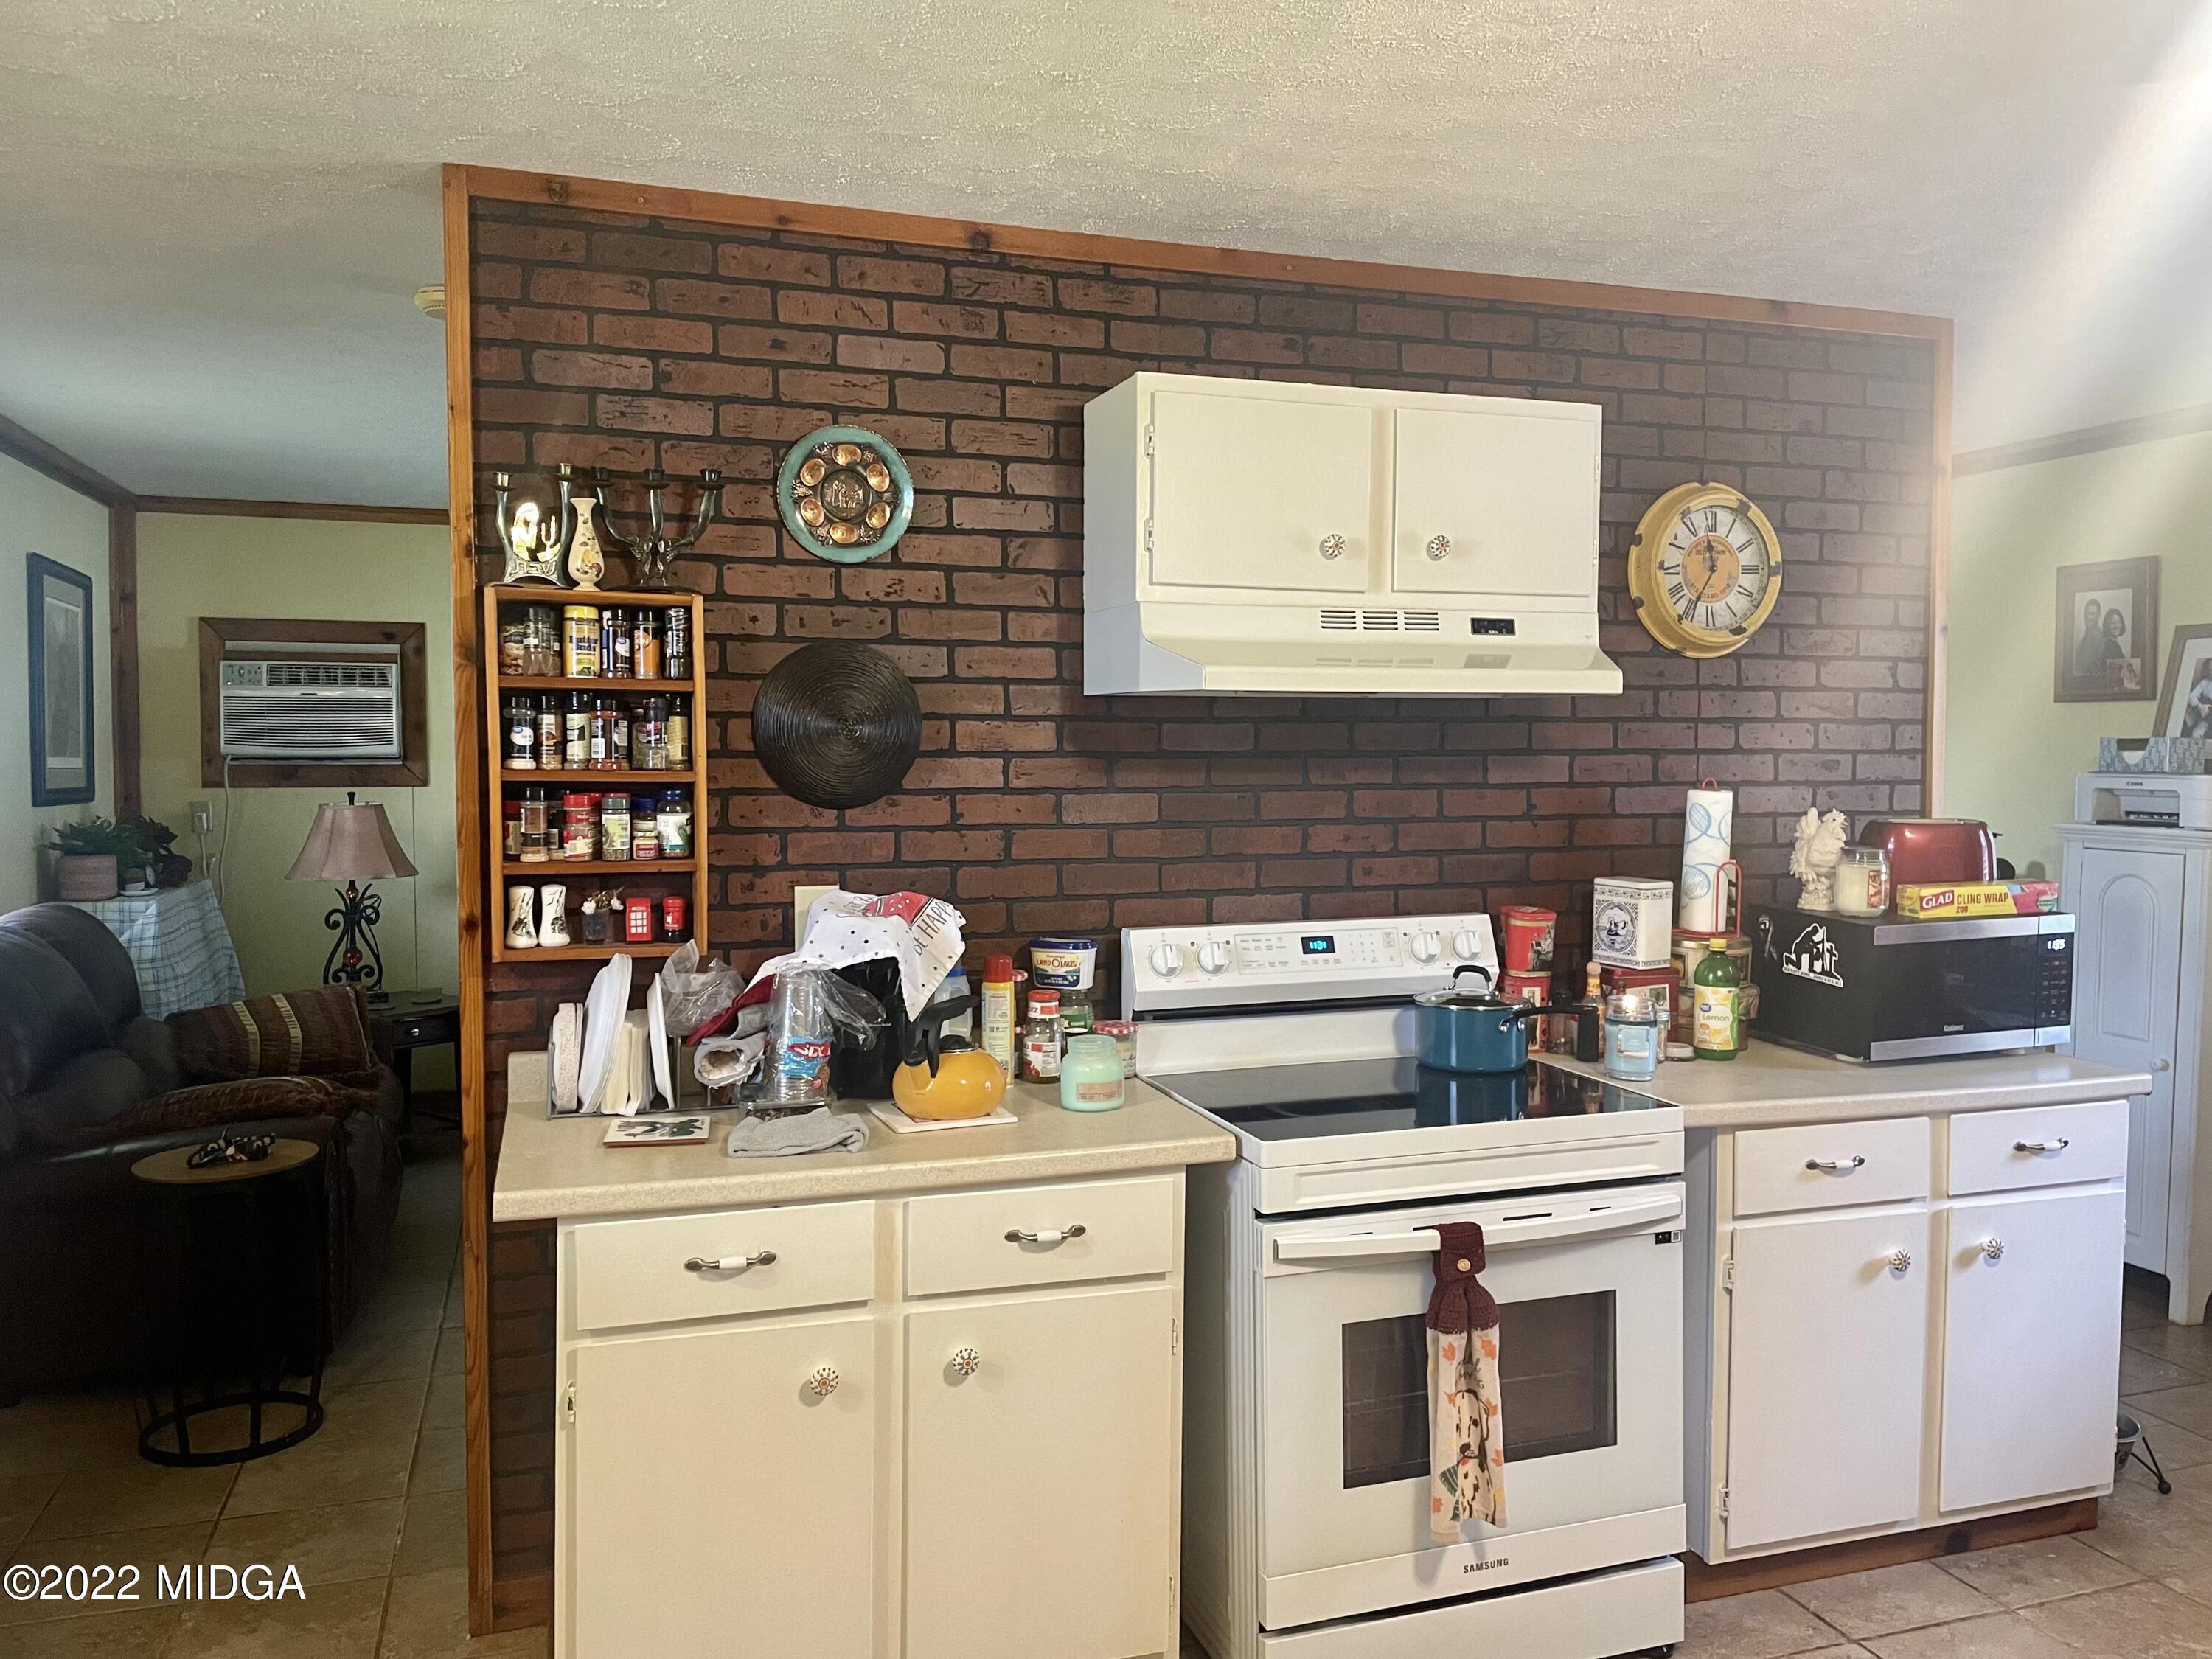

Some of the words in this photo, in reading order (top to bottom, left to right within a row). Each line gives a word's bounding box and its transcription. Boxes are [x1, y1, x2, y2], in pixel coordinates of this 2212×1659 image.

[509, 560, 557, 576] שבת
[1921, 893, 1953, 909] GLAD
[1957, 894, 1982, 905] CLING
[1983, 891, 2009, 903] WRAP
[1702, 1012, 1730, 1022] Lemon
[1463, 1557, 1509, 1573] SAMSUNG
